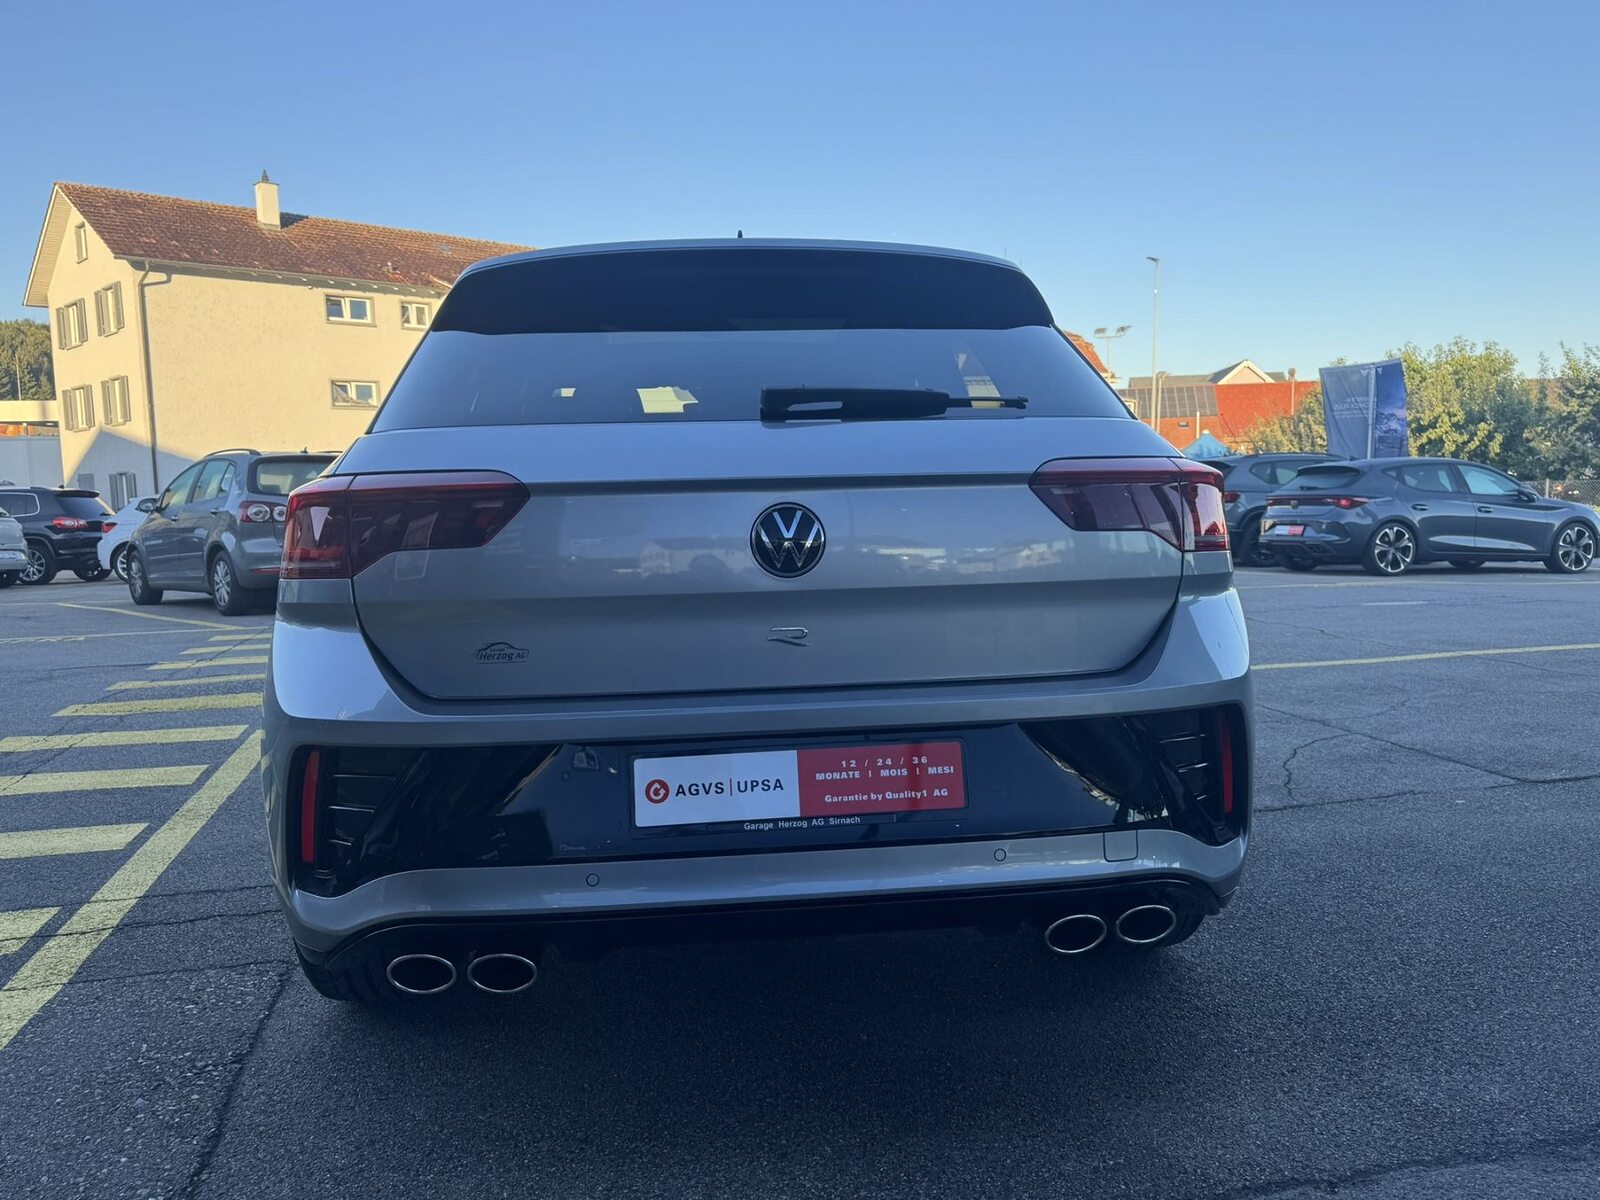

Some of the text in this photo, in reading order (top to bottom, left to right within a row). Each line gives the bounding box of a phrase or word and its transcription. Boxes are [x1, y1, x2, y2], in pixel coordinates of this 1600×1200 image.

[756, 509, 821, 569] VW
[768, 627, 809, 647] R
[480, 652, 526, 661] Herzog AG
[841, 760, 857, 768] 12
[877, 758, 892, 766] 24
[912, 756, 928, 764] 36
[815, 770, 860, 780] MONATE
[880, 768, 908, 777] MOIS
[928, 766, 954, 775] MESI
[675, 778, 784, 797] AGVS UPSA
[825, 788, 948, 802] Garantie by Quality1 AG
[743, 816, 861, 831] Garage Herzog AG Sirnach
